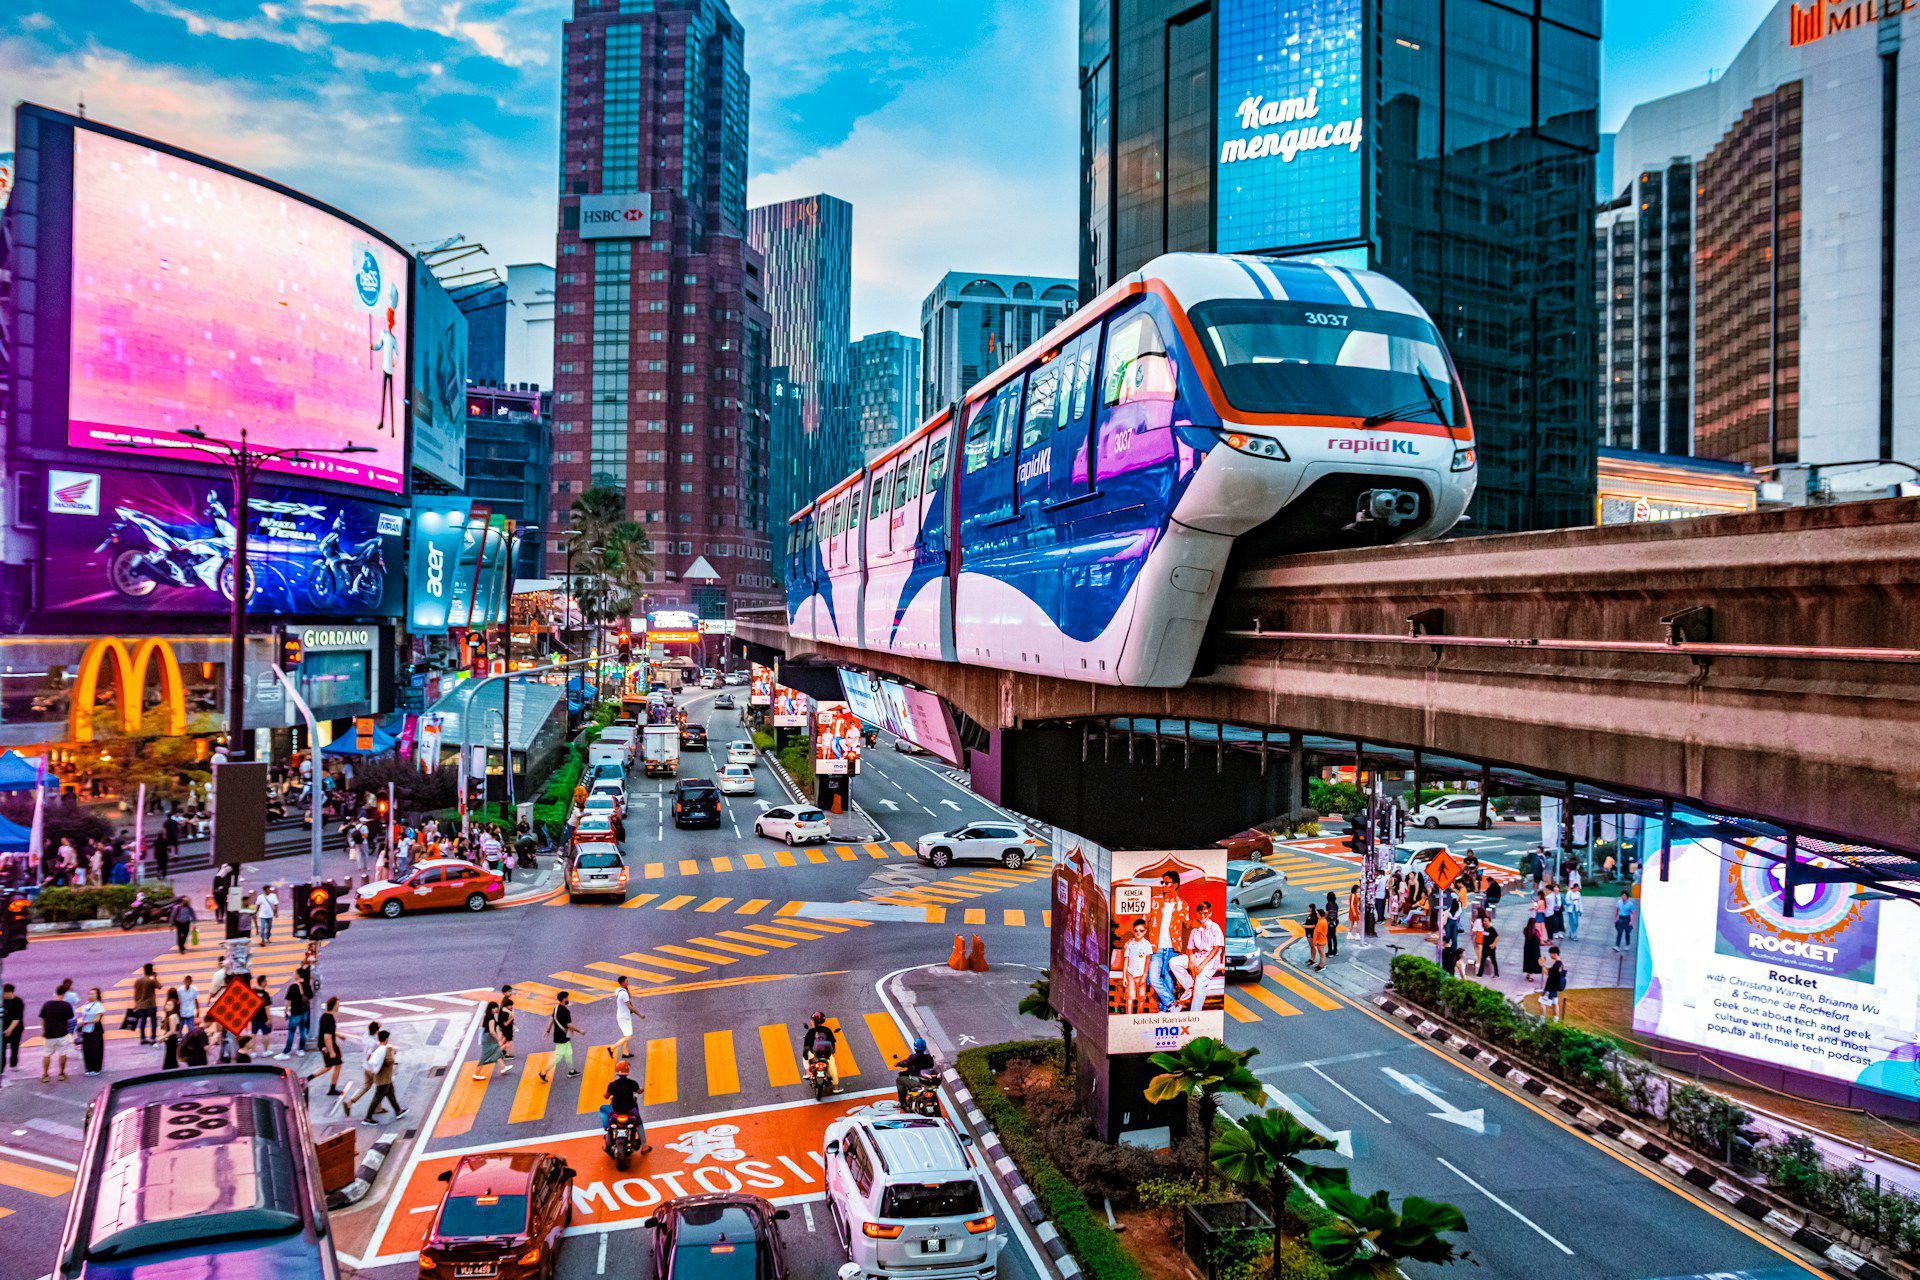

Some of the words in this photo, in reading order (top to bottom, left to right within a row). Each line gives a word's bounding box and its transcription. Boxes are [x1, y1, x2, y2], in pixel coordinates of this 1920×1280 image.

[1238, 87, 1319, 129] Kami
[584, 210, 622, 223] HSBC
[1304, 312, 1349, 326] 3037
[1114, 427, 1133, 454] 3037
[1328, 437, 1420, 455] rapidKL
[427, 541, 443, 598] acer
[304, 629, 369, 648] GIORDANO
[1121, 901, 1146, 912] RM59
[1748, 932, 1839, 963] ROCKET
[1768, 970, 1818, 989] Rocket
[1706, 974, 1726, 982] with
[1729, 976, 1772, 992] Christina
[1776, 986, 1815, 1002] Warren,
[1818, 994, 1858, 1011] Brianna
[1862, 1003, 1880, 1015] Wu
[1731, 989, 1739, 997] &
[1743, 991, 1780, 1006] Simone
[1782, 1001, 1796, 1010] de
[1799, 1003, 1850, 1022] Rochefort
[1155, 1025, 1190, 1037] max
[1162, 1016, 1200, 1024] Ramadan
[1714, 998, 1739, 1010] Geek
[1742, 1006, 1759, 1015] out
[1762, 1010, 1792, 1022] about
[1795, 1017, 1817, 1028] tech
[1820, 1023, 1841, 1033] and
[1843, 1029, 1872, 1040] geek
[1715, 1012, 1749, 1025] culture
[1751, 1020, 1773, 1030] with
[1776, 1025, 1792, 1035] the
[1795, 1027, 1815, 1040] first
[1817, 1035, 1838, 1046] and
[1840, 1040, 1868, 1053] most
[1707, 1023, 1746, 1037] popular
[1749, 1031, 1799, 1050] all-female
[1802, 1043, 1825, 1055] tech
[1827, 1050, 1874, 1067] podcast.
